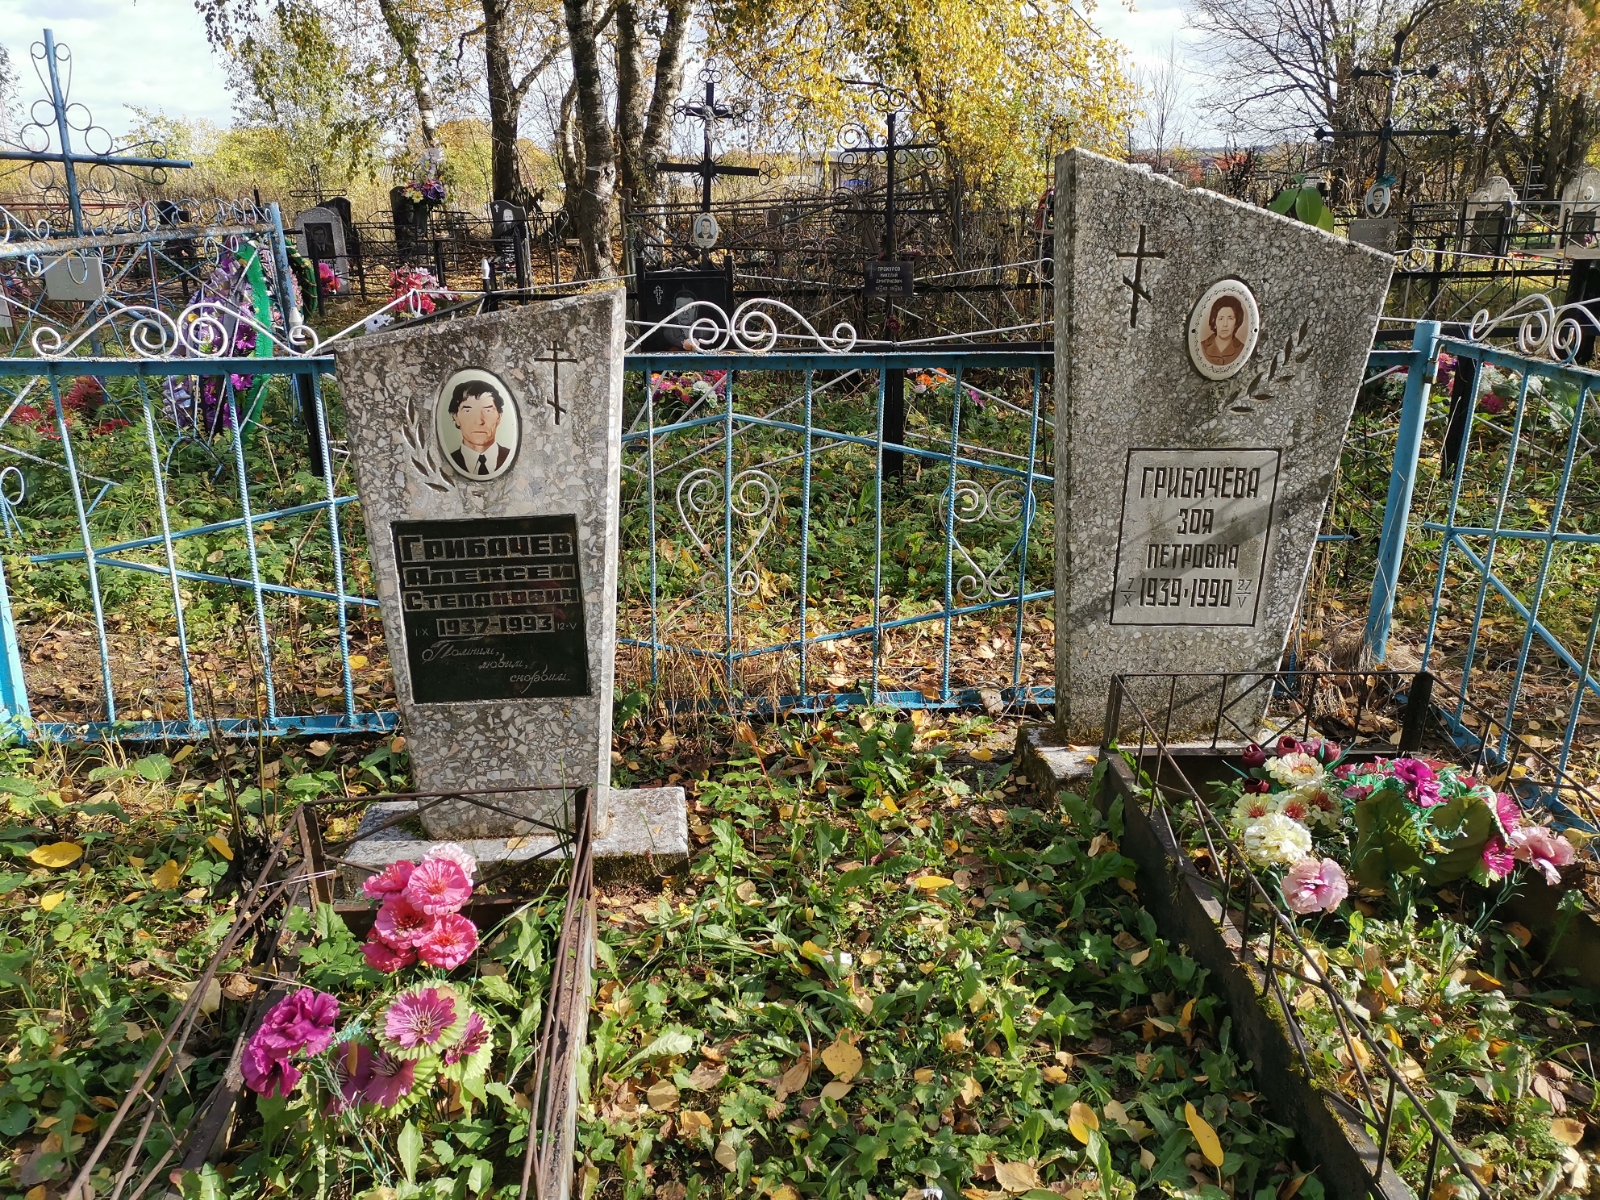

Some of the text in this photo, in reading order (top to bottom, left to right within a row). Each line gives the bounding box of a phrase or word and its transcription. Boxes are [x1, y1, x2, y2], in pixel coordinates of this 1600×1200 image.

[1140, 467, 1261, 498] ГРИБАЧЕВА
[1177, 508, 1214, 535] ЗОЯ
[1146, 544, 1240, 569] ПЕТРОВНА
[436, 613, 555, 637] 1937-1993
